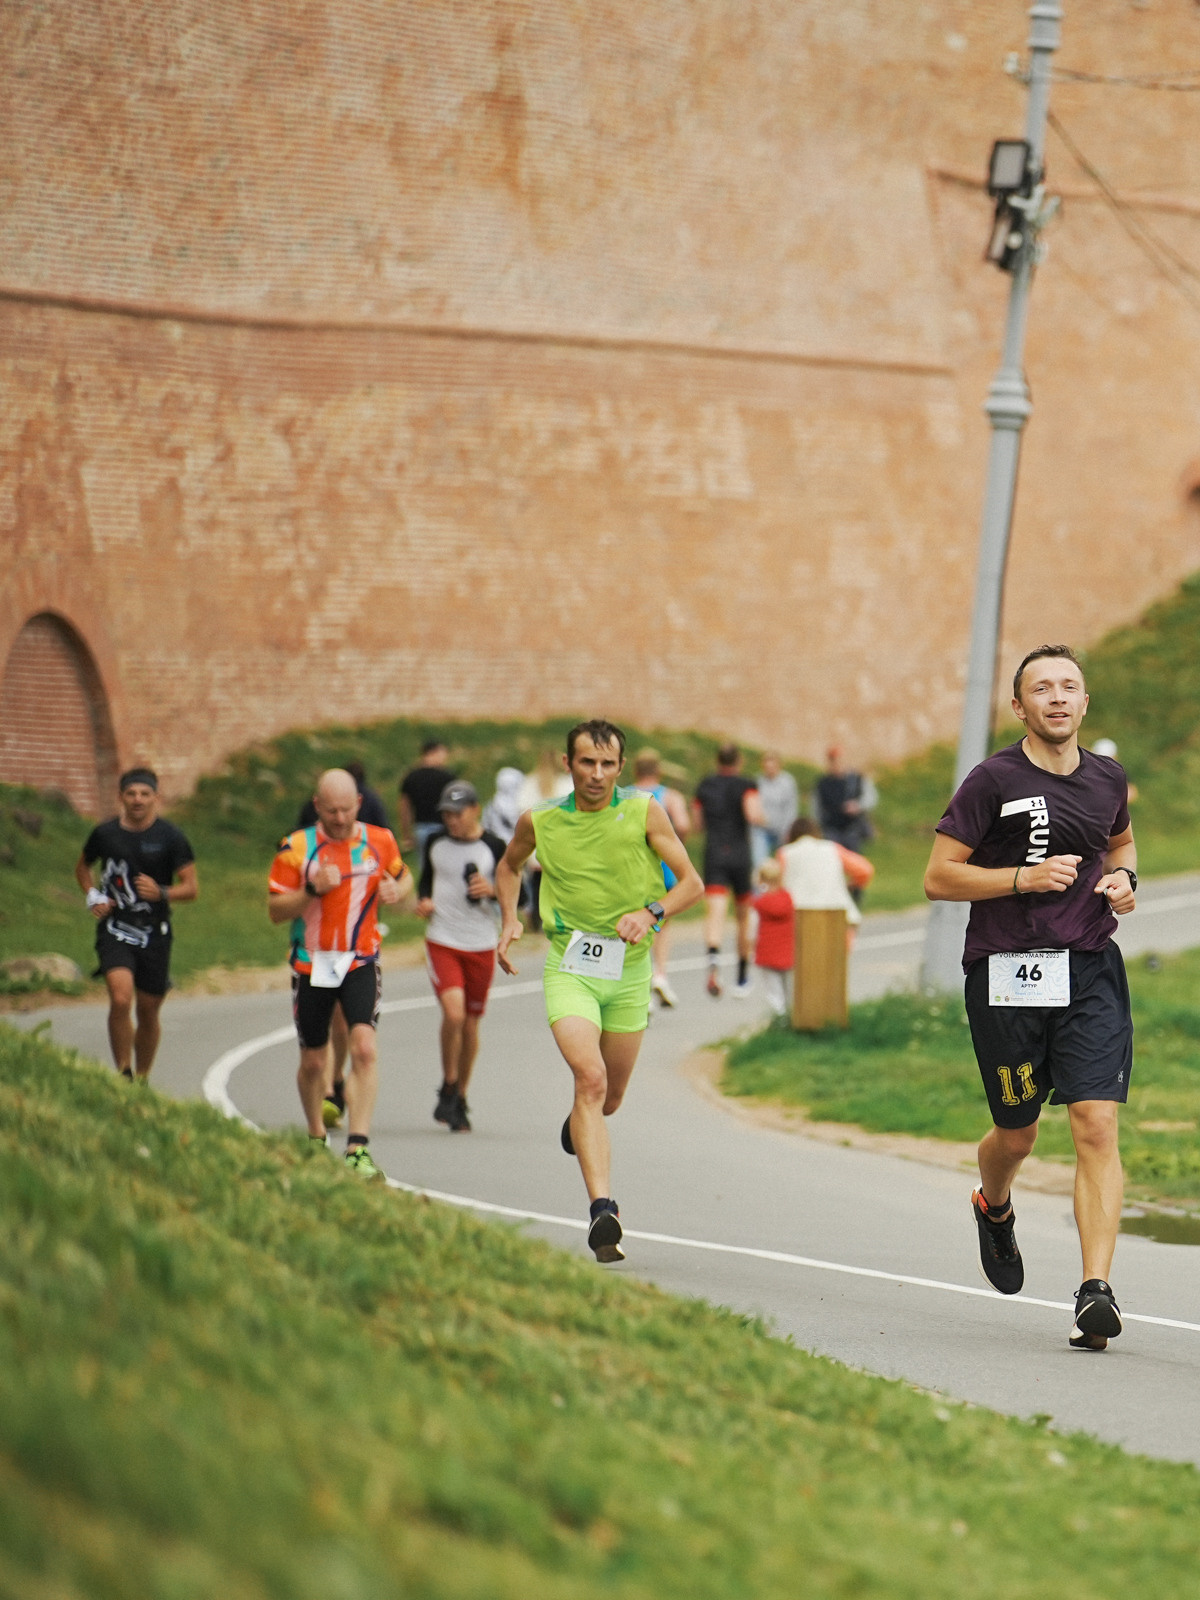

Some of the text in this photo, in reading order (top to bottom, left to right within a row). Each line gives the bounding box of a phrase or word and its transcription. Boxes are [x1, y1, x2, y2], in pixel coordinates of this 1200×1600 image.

[1025, 808, 1050, 863] RUN
[582, 942, 603, 957] 20
[1015, 963, 1043, 982] 46
[997, 1061, 1038, 1106] 11
